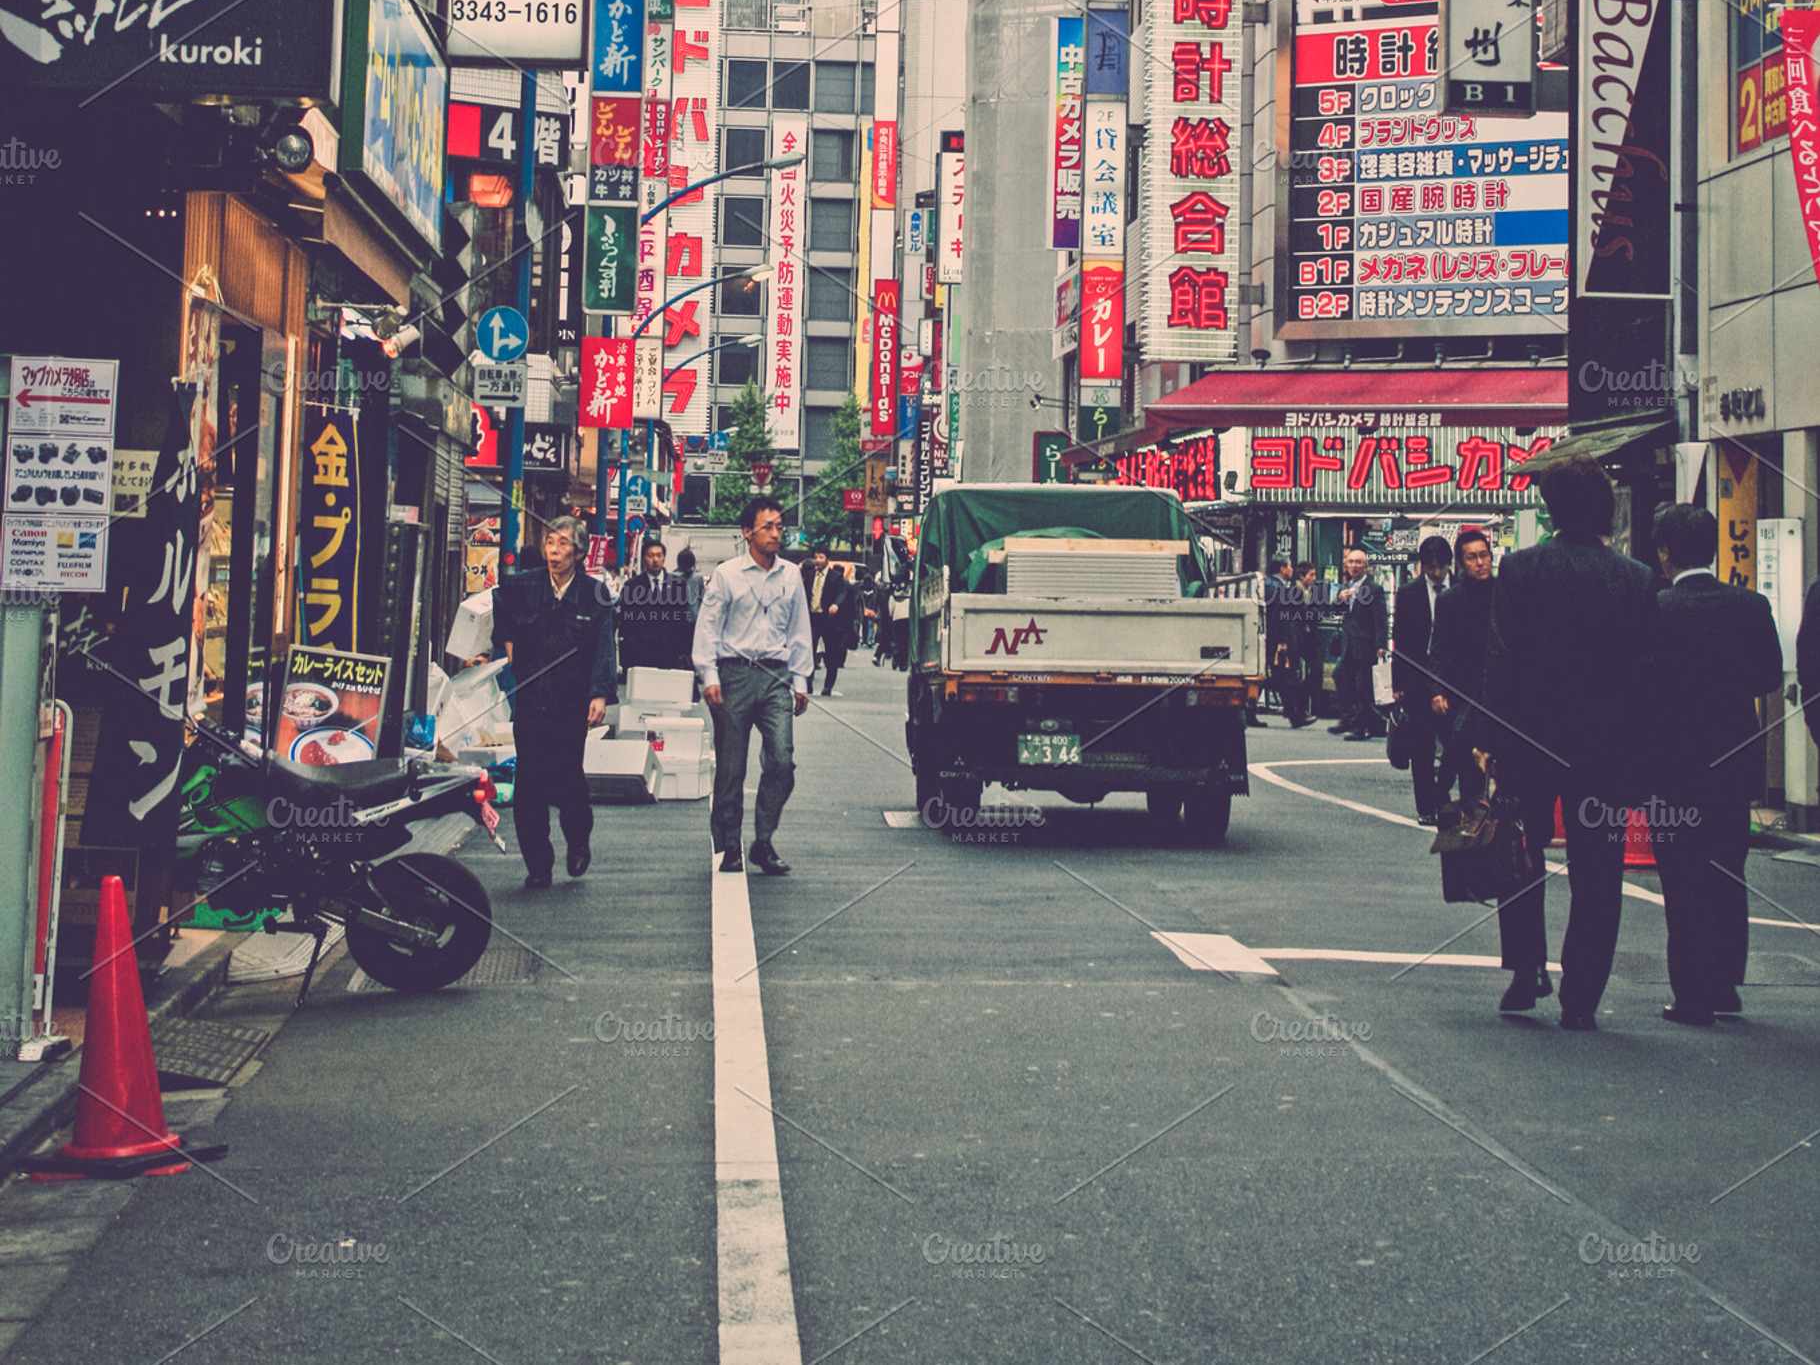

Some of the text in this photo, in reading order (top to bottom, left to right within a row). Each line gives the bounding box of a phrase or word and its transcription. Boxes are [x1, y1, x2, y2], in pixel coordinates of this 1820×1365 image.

[453, 0, 578, 25] 3343-1616
[159, 34, 263, 66] kuroki
[1317, 82, 1438, 116] 5F クロック
[1096, 109, 1115, 123] 2F
[1056, 43, 1084, 220] 中古カメラ販売
[1317, 122, 1353, 149] 4F
[1317, 157, 1353, 183] 3F
[1090, 127, 1119, 247] 貸会議室
[1317, 181, 1510, 217] 2F 国産腕時計
[1317, 217, 1494, 250] 1F カジュアル時計
[1299, 257, 1350, 285] B1F
[1299, 292, 1350, 320] B2F
[1091, 297, 1113, 374] カレー
[478, 381, 523, 394] 一方通行
[1284, 412, 1375, 428] ヨドバシカメラ
[1045, 444, 1062, 485] らー
[11, 528, 48, 538] Canon
[308, 422, 353, 649] 金・プラ
[9, 558, 46, 567] CONTAX
[291, 651, 384, 686] カレーライスセット
